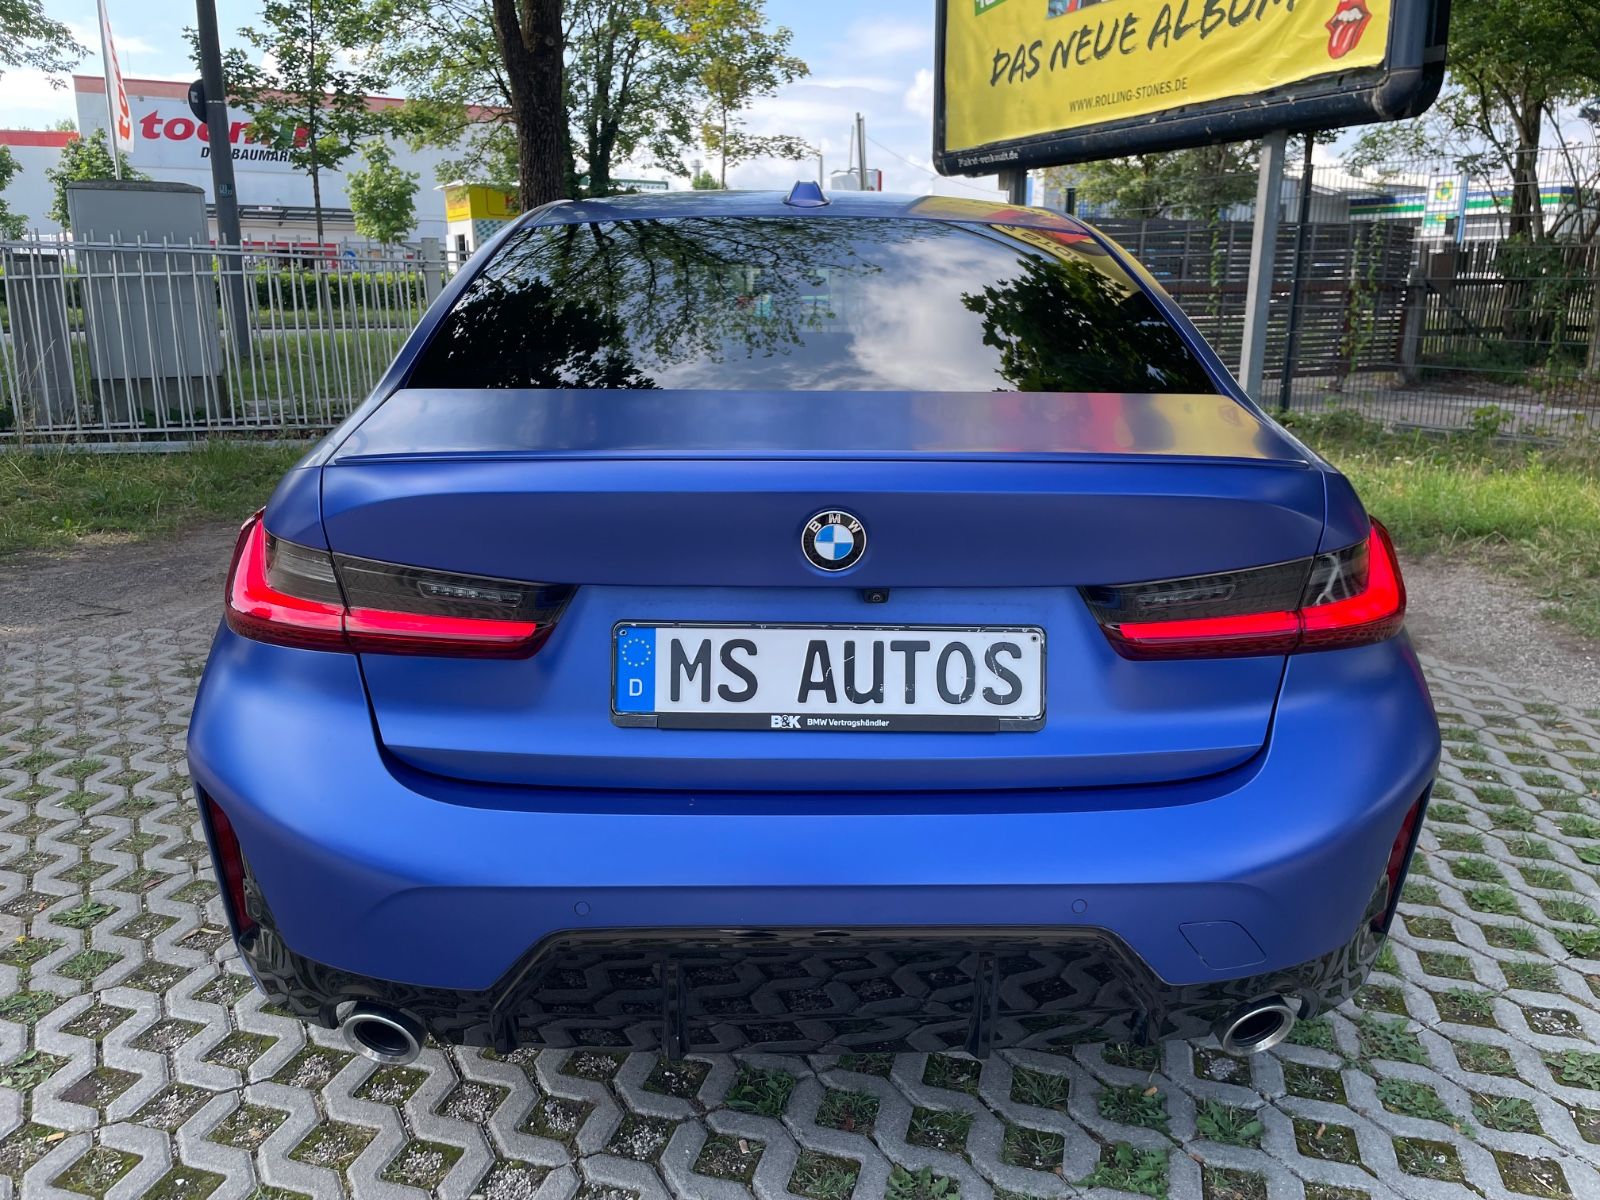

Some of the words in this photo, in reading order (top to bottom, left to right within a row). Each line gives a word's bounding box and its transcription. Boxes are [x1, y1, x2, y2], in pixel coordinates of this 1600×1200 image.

[989, 39, 1042, 87] DAS
[1049, 12, 1140, 72] NEUE
[1069, 77, 1188, 112] WWW.ROLLING-STONES.DE
[232, 149, 296, 162] BAUMAR
[808, 513, 862, 534] BMW
[669, 637, 758, 702] MS
[797, 639, 1024, 706] AUTOS
[628, 678, 643, 697] D
[770, 714, 802, 729] B&K
[807, 718, 828, 727] BMW
[829, 718, 891, 728] Vertragshändler
